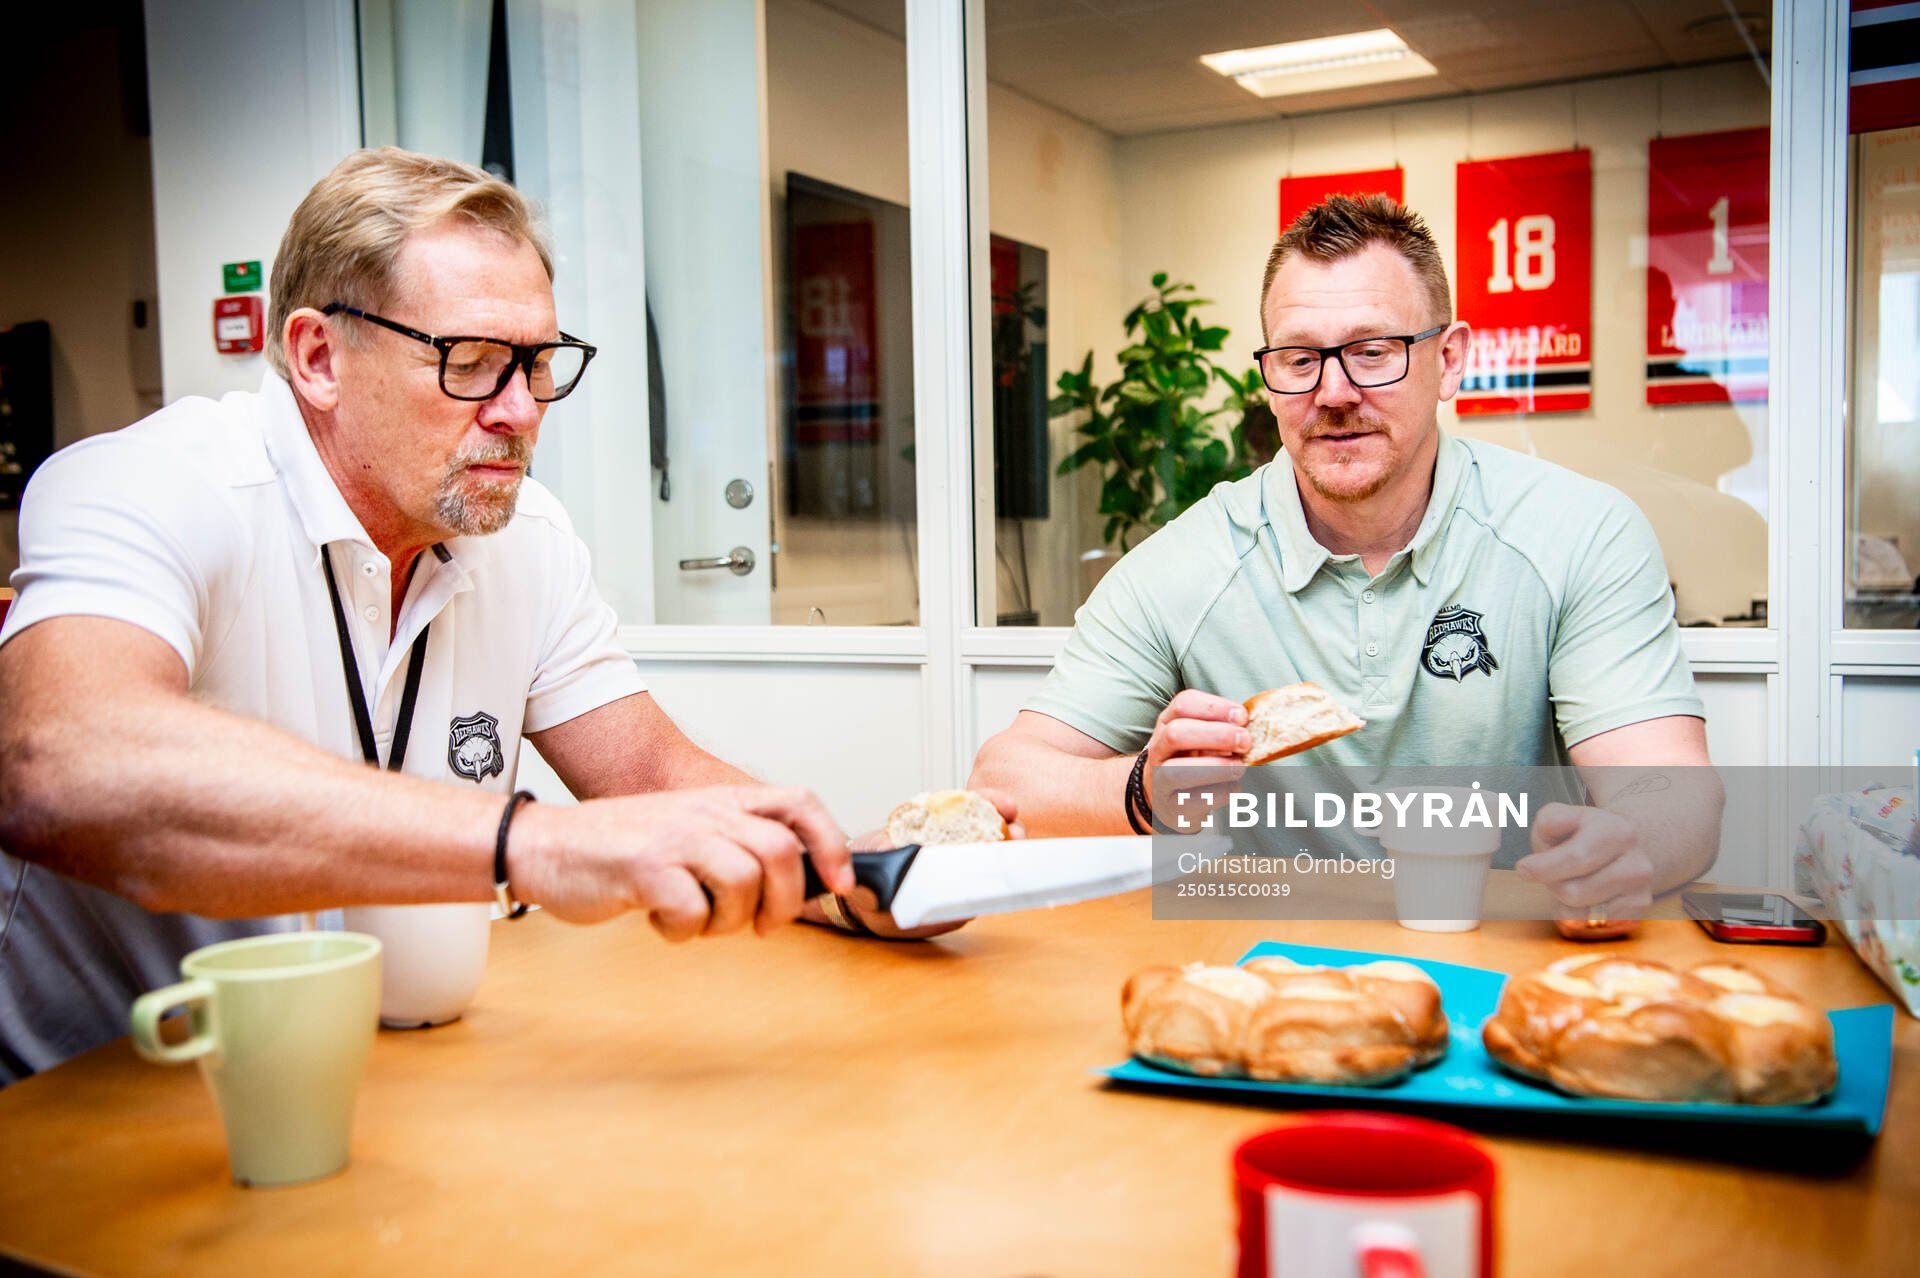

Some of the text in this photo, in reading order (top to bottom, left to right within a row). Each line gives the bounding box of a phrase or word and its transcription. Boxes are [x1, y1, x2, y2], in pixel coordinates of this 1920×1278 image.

[1487, 214, 1556, 294] 18
[1707, 196, 1734, 275] 1
[1429, 618, 1473, 642] REDHAWKS
